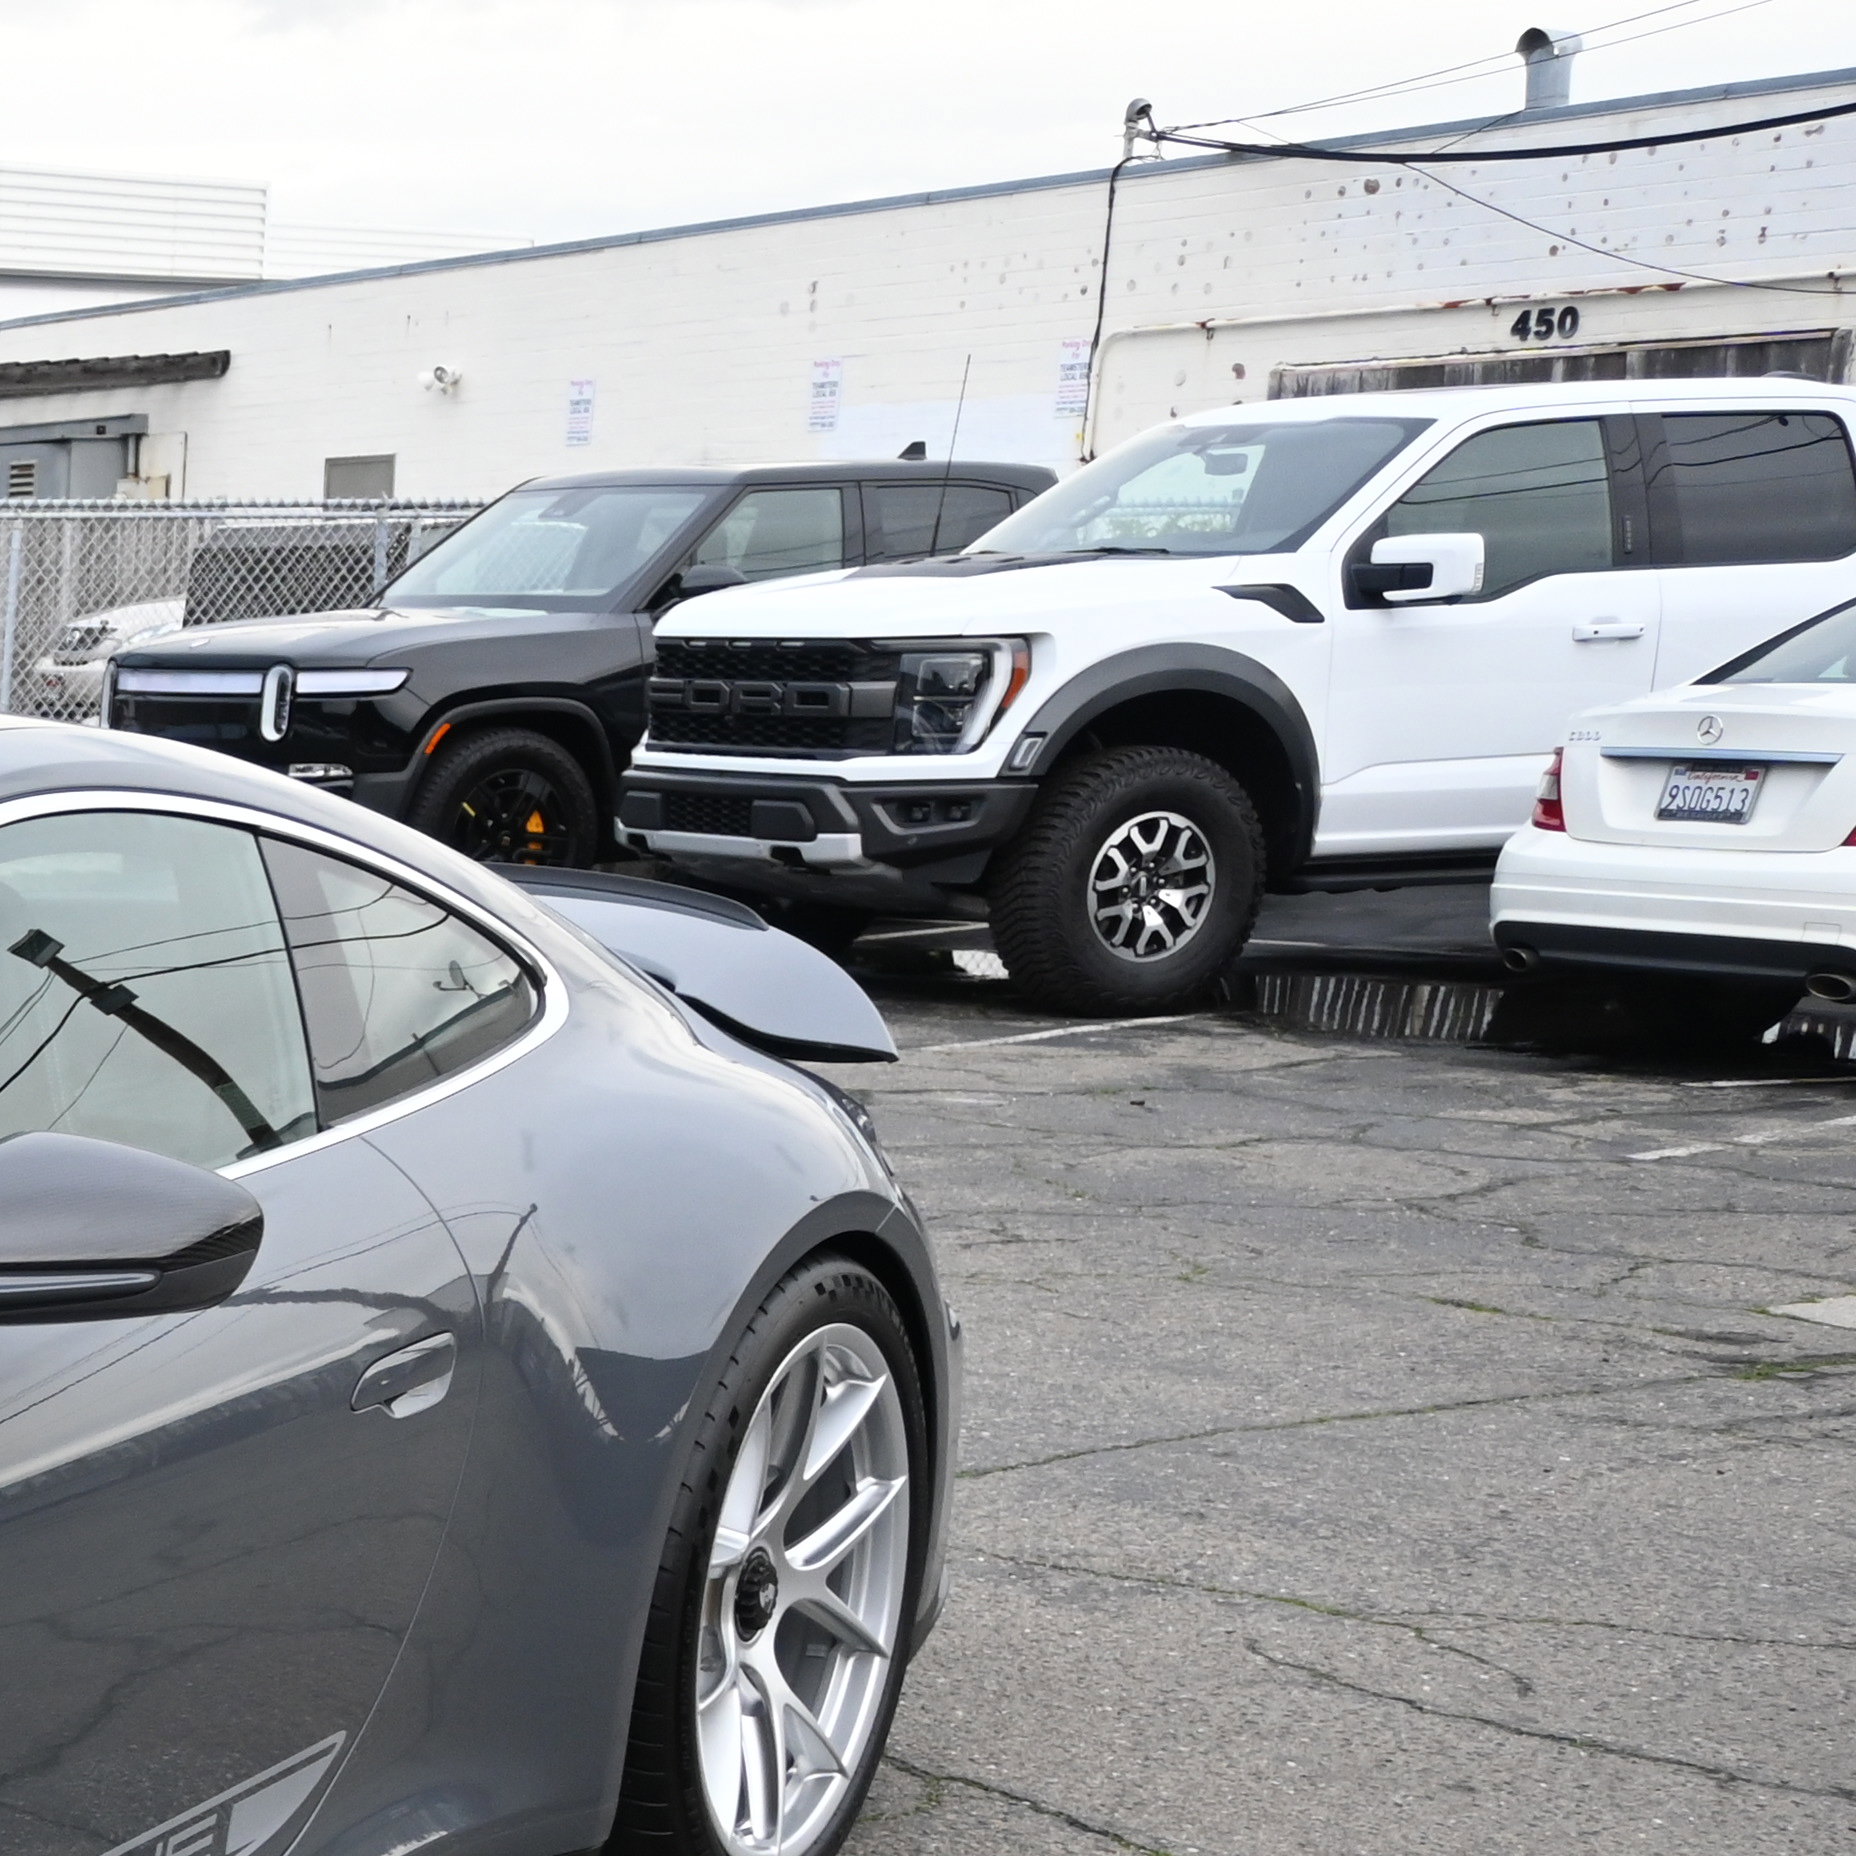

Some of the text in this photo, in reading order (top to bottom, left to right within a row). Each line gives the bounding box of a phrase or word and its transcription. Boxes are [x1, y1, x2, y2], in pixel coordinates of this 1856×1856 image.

[1510, 306, 1580, 341] 450
[646, 677, 851, 717] FORD
[1688, 771, 1744, 784] California
